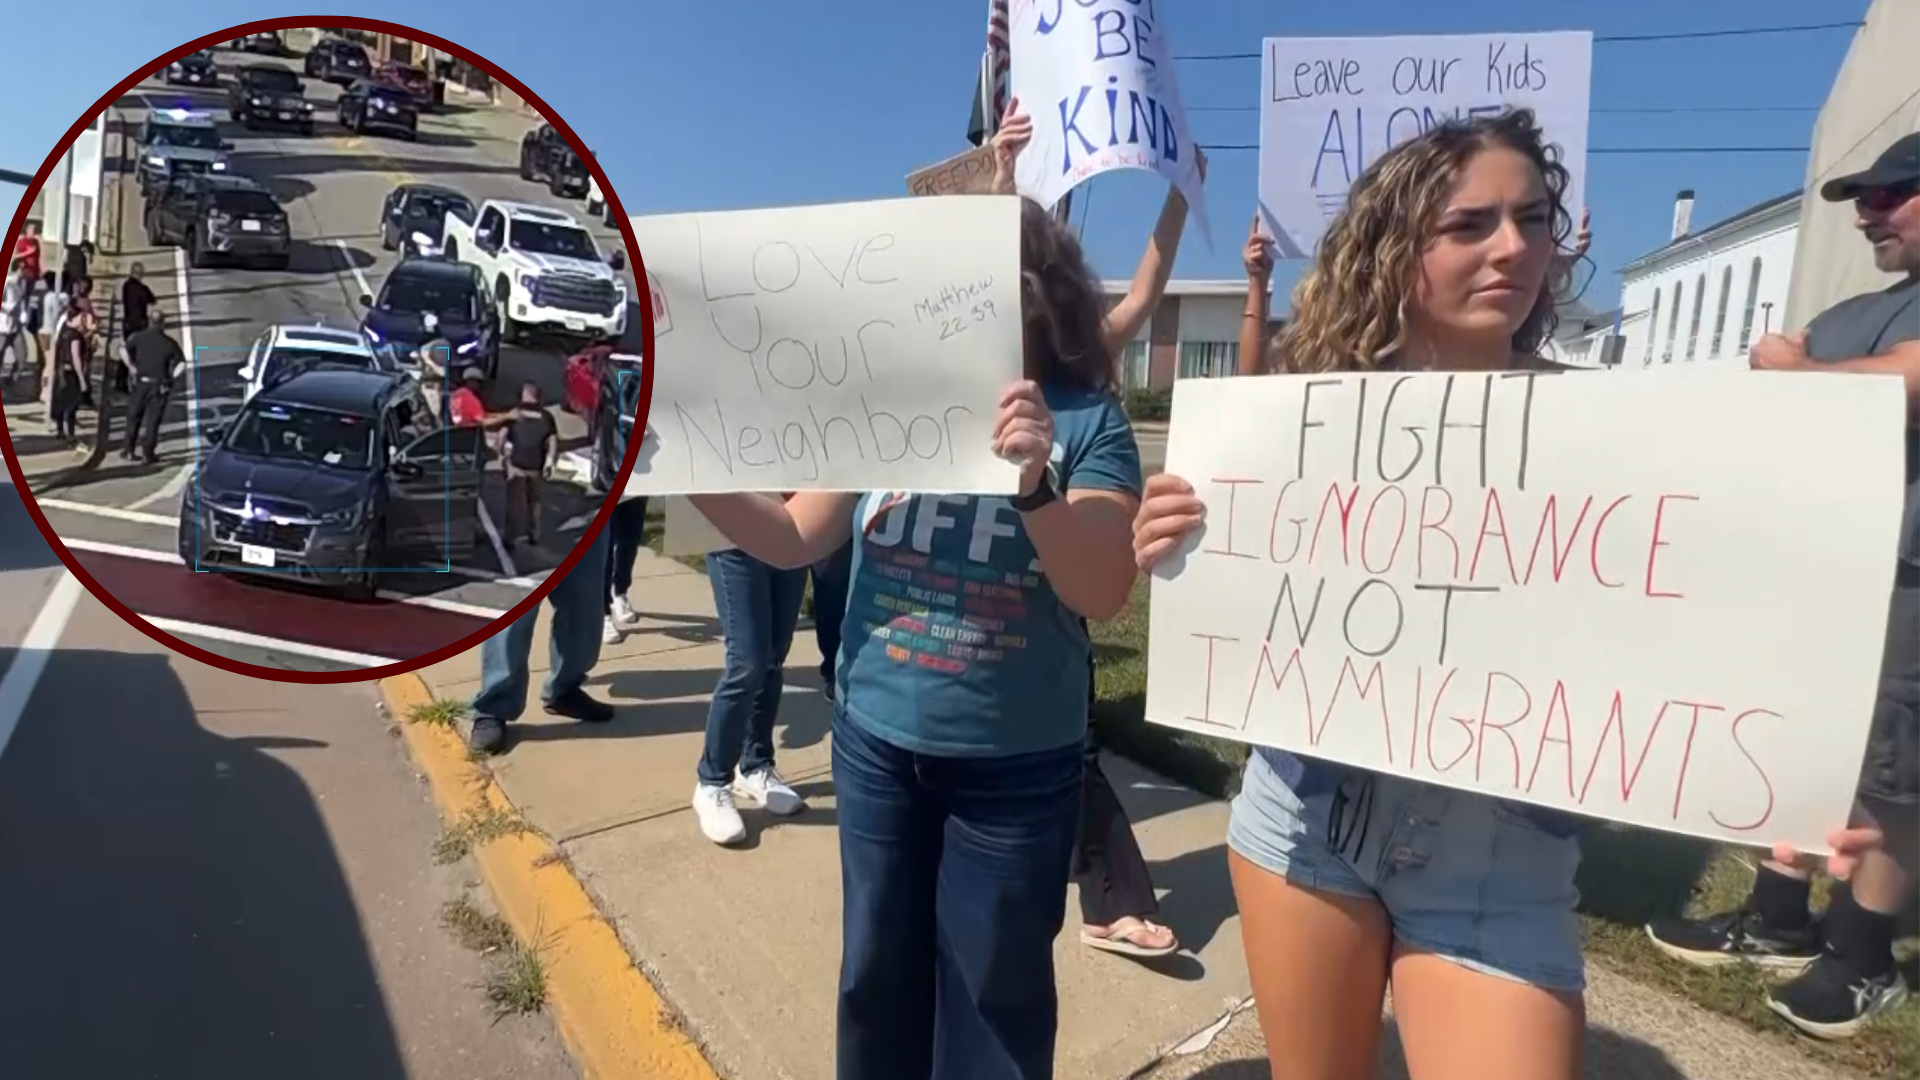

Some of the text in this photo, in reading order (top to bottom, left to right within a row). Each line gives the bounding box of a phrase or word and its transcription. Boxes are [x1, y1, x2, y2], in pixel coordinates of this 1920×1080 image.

[1092, 9, 1156, 67] BE
[1271, 42, 1547, 102] Leave our Kids
[912, 150, 998, 196] FREEDO
[696, 217, 898, 302] Love
[914, 274, 994, 322] Matthew
[710, 305, 896, 395] Your
[939, 300, 998, 341] 22 39
[674, 393, 974, 483] Neighbor
[1297, 372, 1563, 491] FIGHT
[1202, 477, 1701, 599] IGNORANCE
[930, 623, 957, 640] CLEAN
[1264, 572, 1501, 666] NOT
[1184, 632, 1786, 832] IMMIGRANTS
